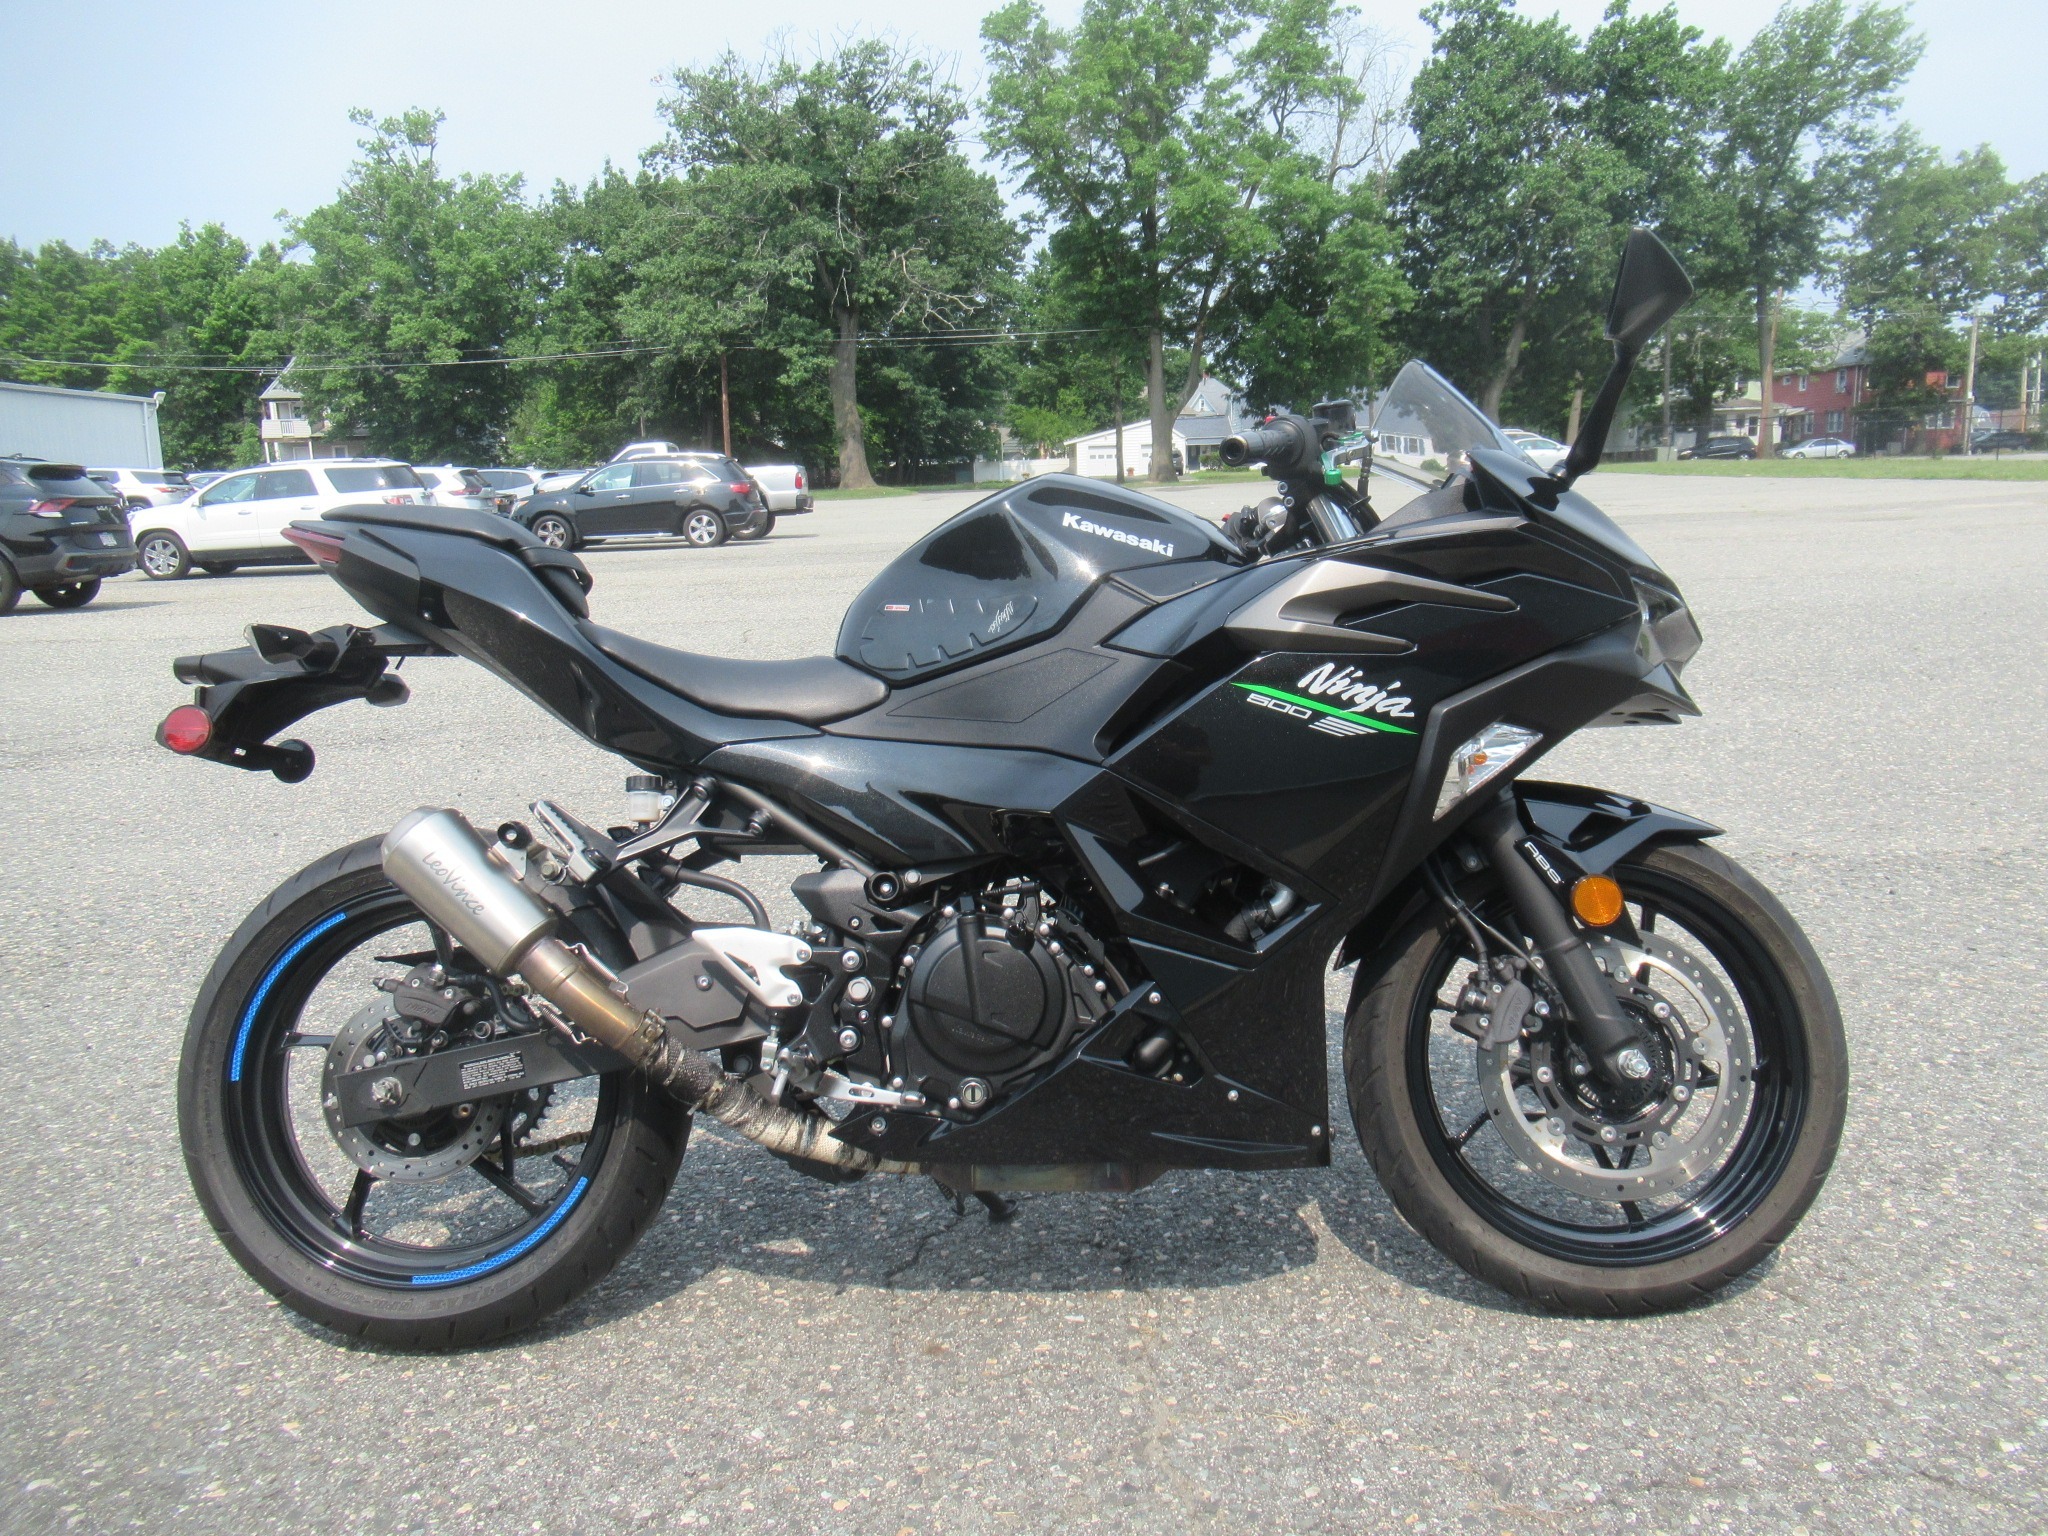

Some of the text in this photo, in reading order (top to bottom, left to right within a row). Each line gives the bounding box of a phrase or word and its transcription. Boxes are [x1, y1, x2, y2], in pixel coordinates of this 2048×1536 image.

[1062, 512, 1174, 557] Kawasaki
[1246, 692, 1312, 719] 500
[1298, 662, 1415, 717] Ninja
[422, 851, 485, 915] LeoVince
[1524, 841, 1561, 884] ABS
